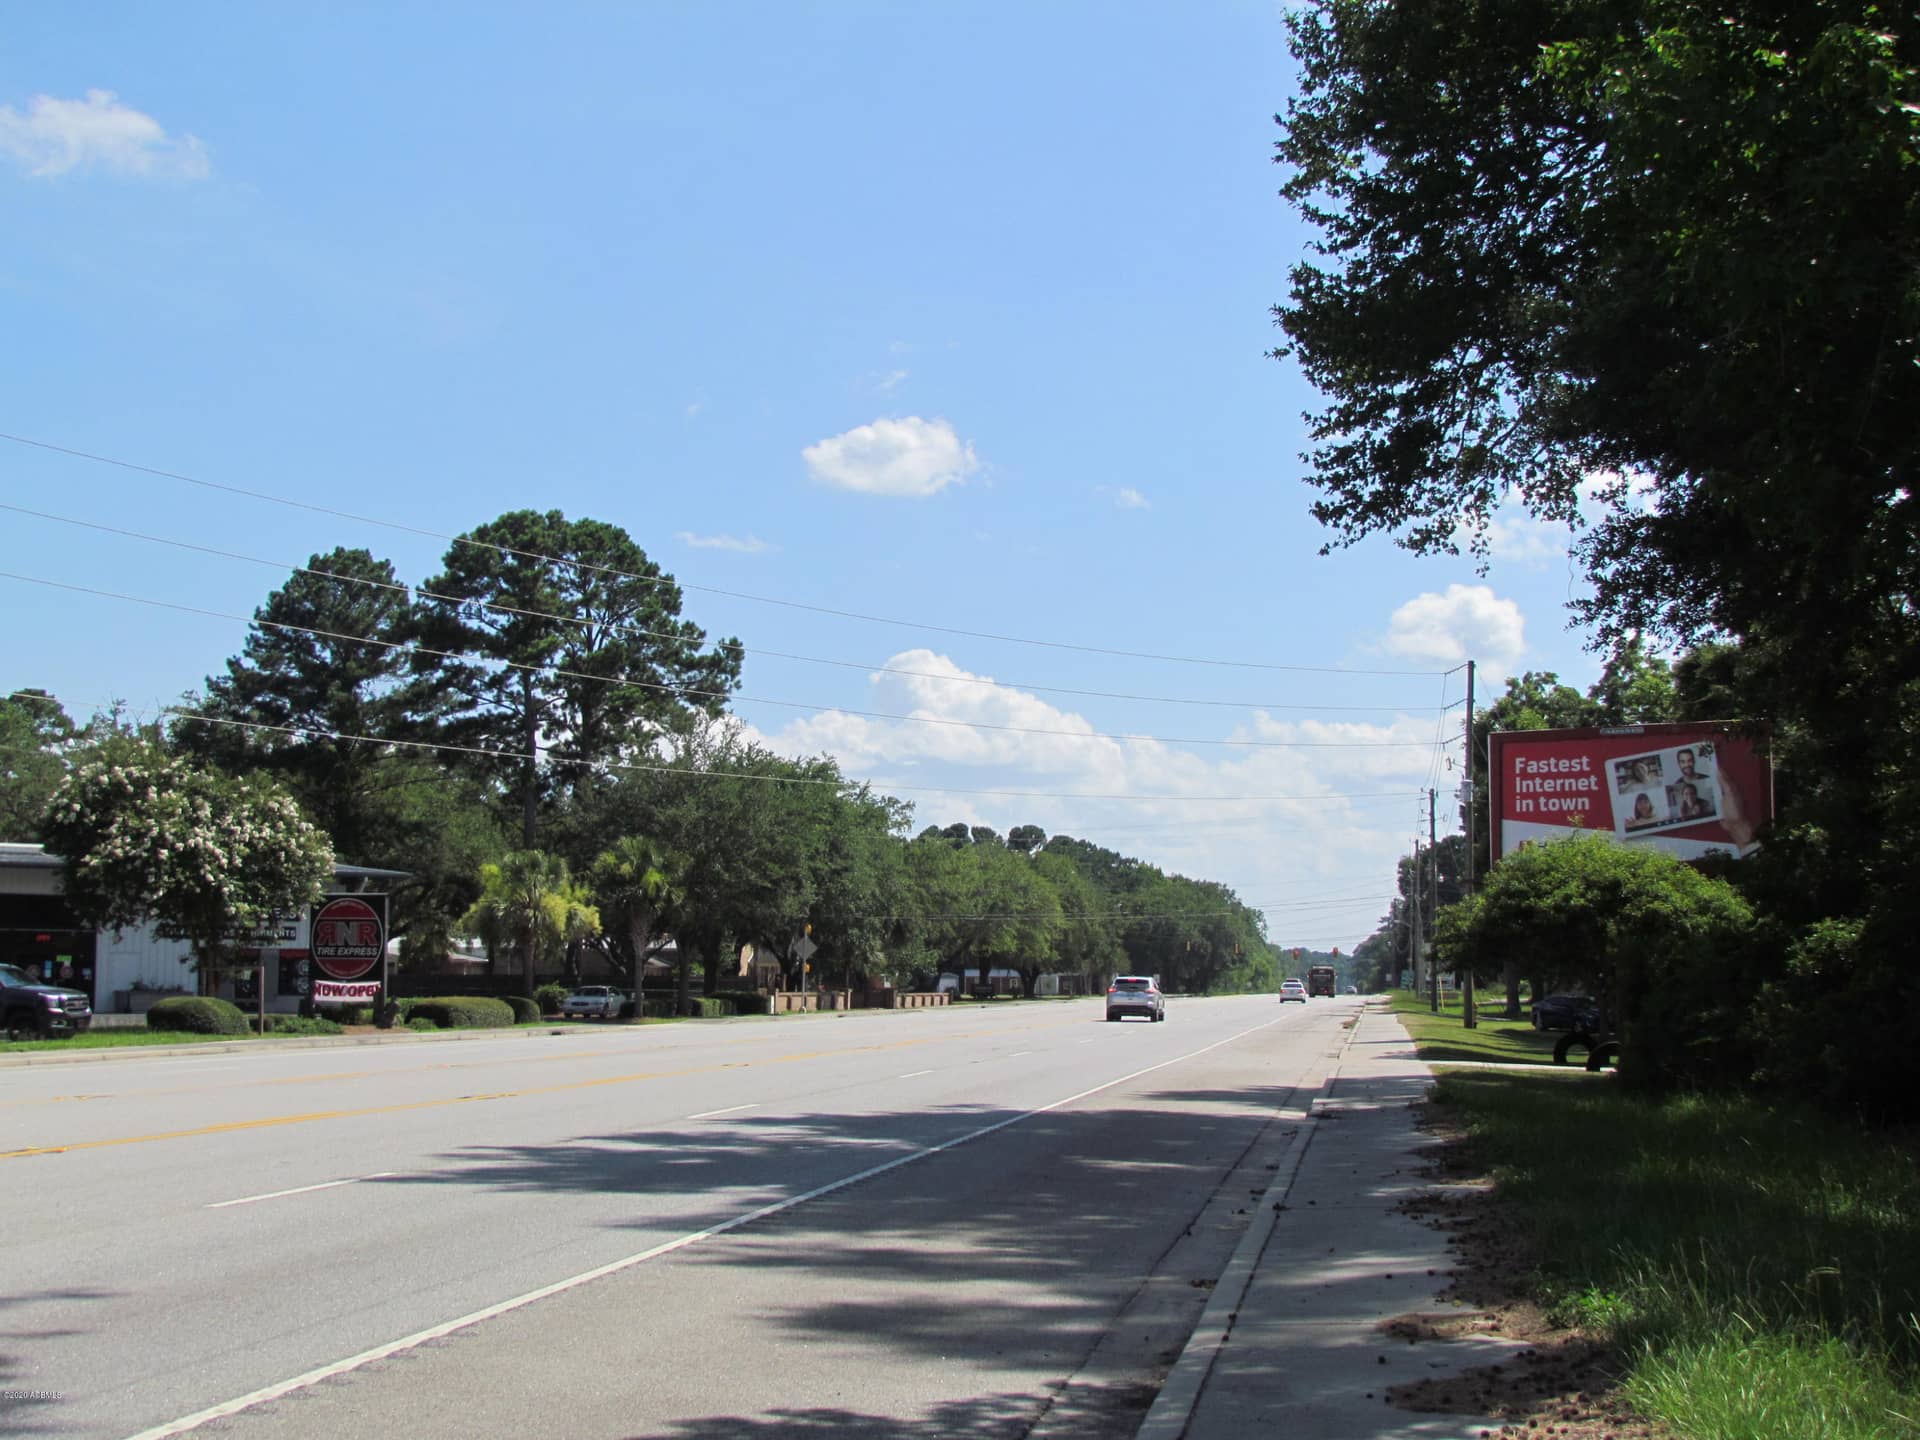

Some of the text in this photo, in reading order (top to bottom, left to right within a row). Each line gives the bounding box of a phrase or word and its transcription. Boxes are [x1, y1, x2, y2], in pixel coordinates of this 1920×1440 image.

[1515, 755, 1591, 774] Fastest
[1515, 775, 1599, 793] Internet
[1515, 795, 1590, 812] in town
[317, 946, 378, 956] TIRE EXPRESS
[313, 983, 346, 997] NOW
